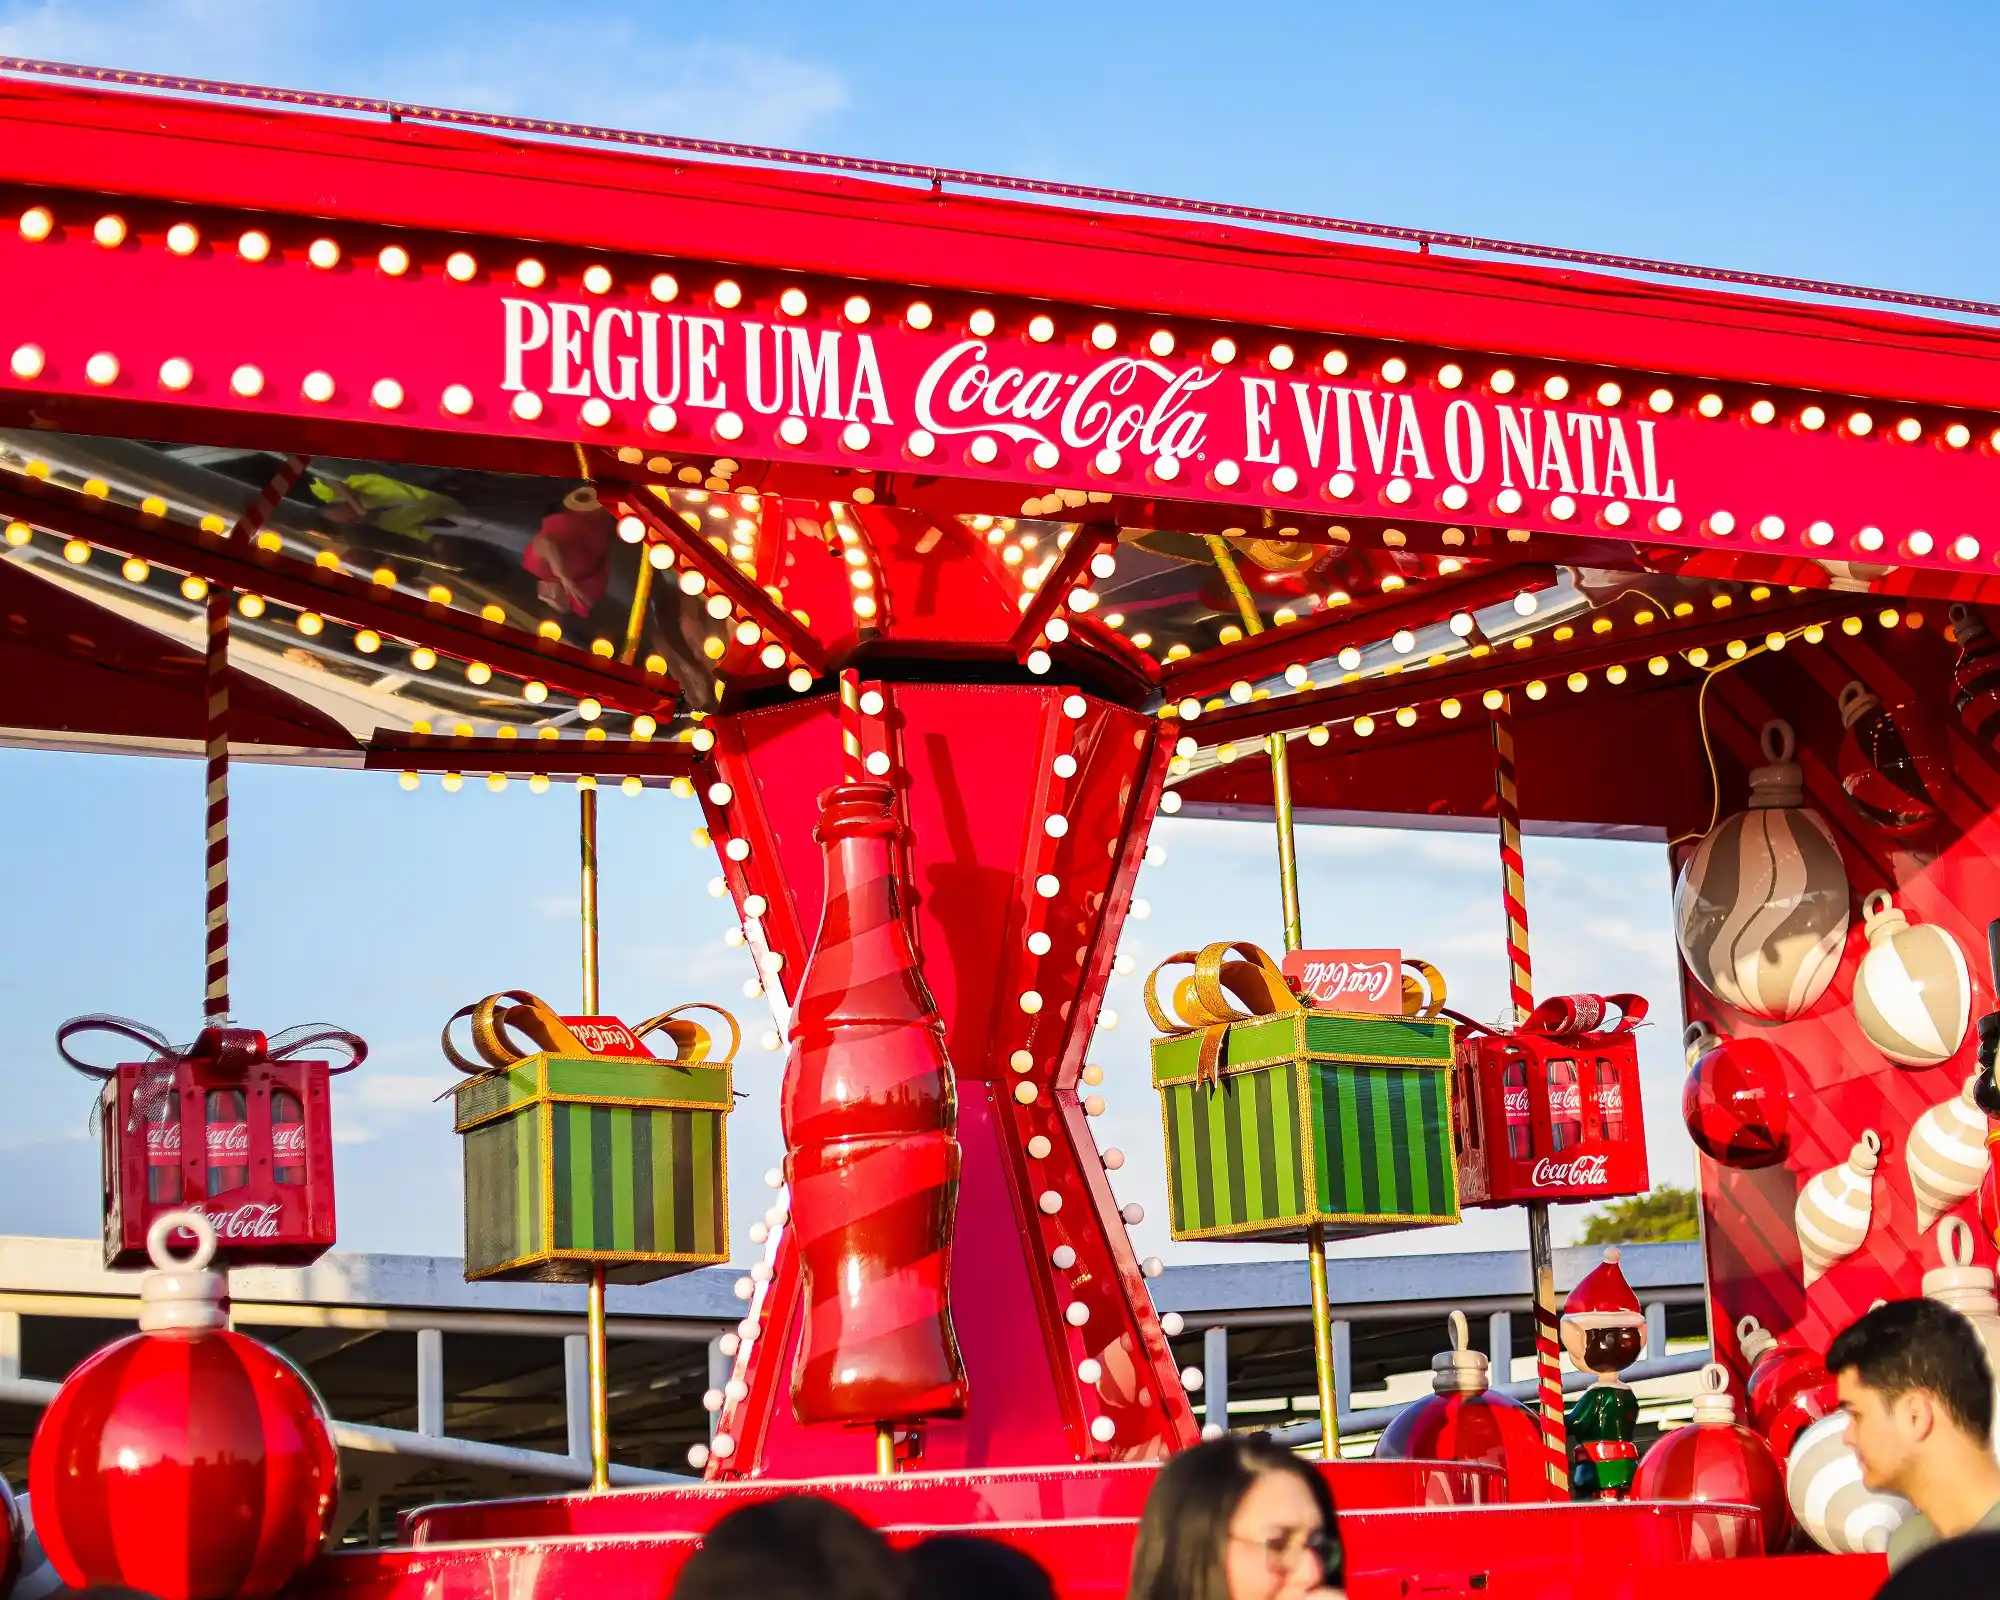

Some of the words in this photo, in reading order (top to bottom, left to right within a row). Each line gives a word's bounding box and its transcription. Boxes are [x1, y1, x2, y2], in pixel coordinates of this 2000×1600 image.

[501, 298, 726, 409] PEGUE
[740, 320, 894, 425] UMA
[914, 340, 1224, 460] Coca-Cola
[1240, 376, 1280, 465] E
[1289, 382, 1435, 480] VIVA
[1444, 399, 1486, 484] O
[1495, 404, 1677, 503] NATAL
[1303, 961, 1393, 1002] Coca-Cola
[1532, 1154, 1609, 1188] Coca-Cola
